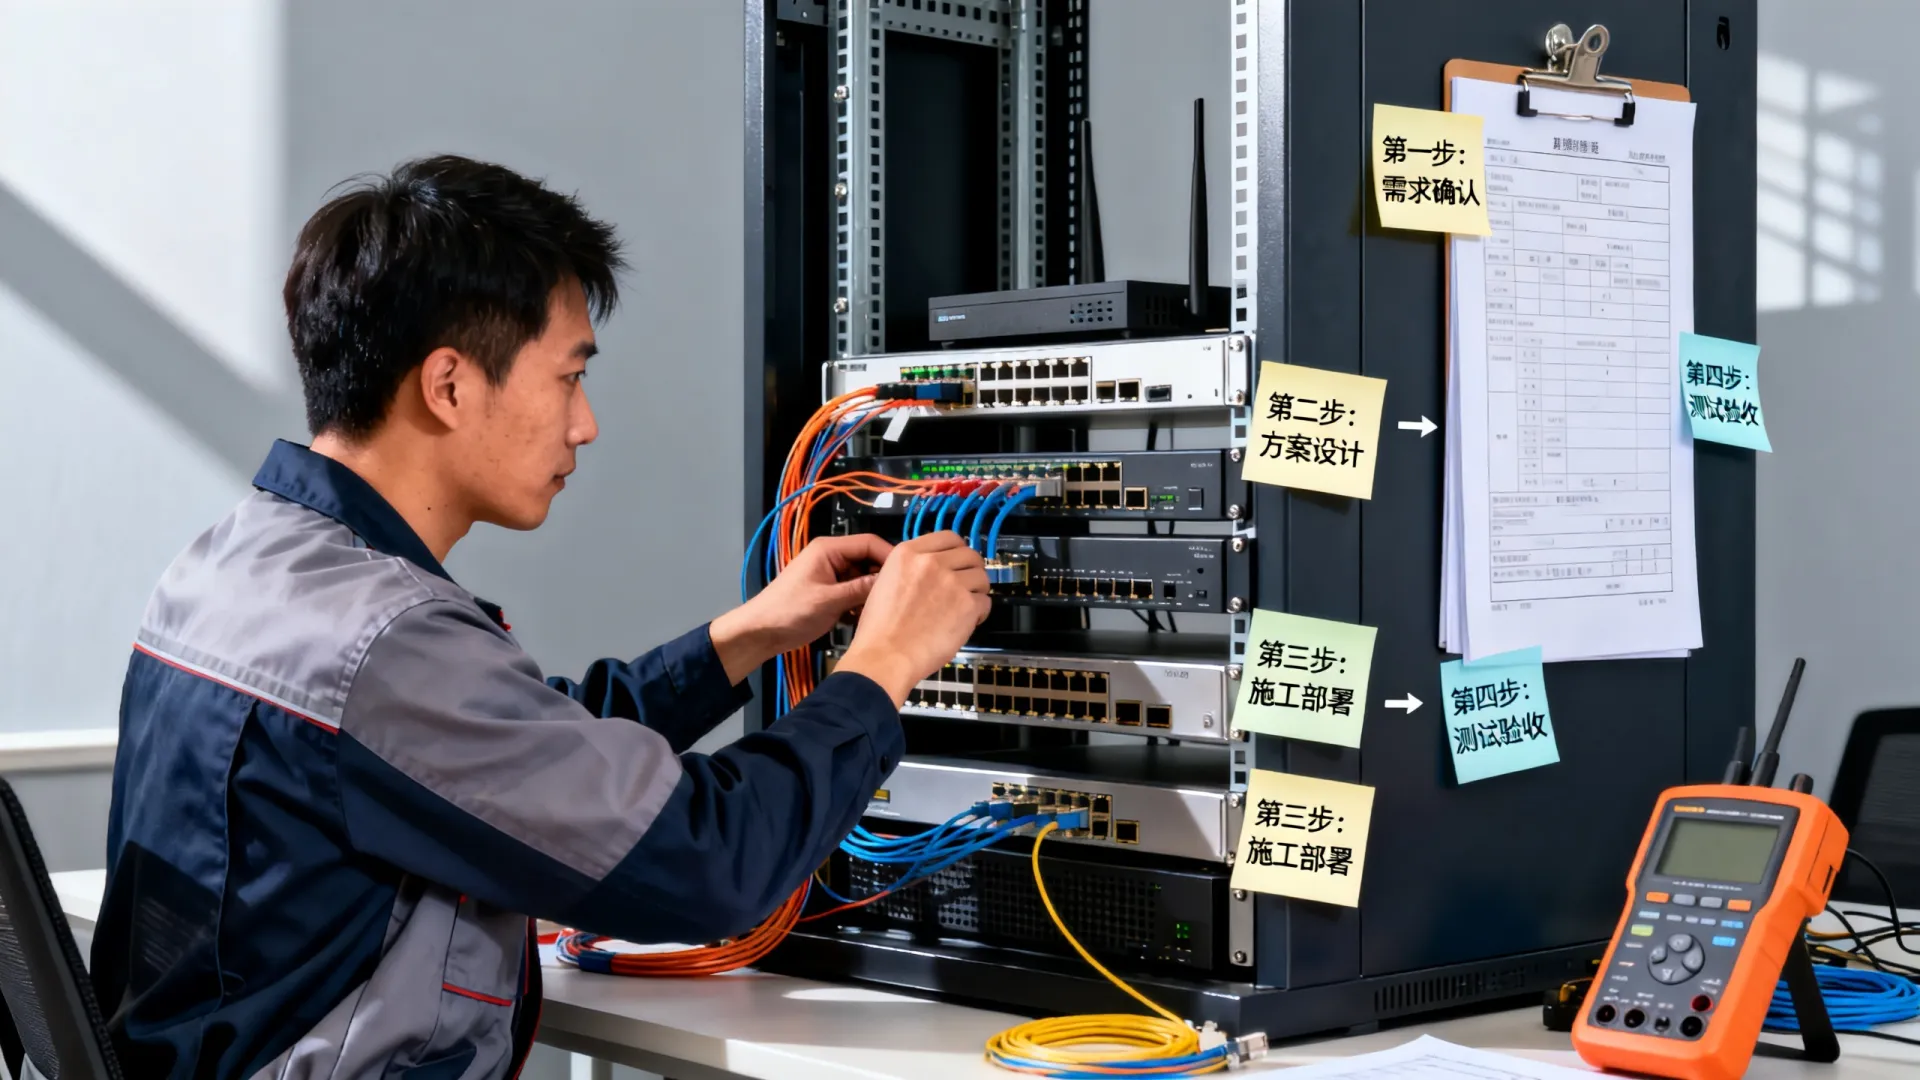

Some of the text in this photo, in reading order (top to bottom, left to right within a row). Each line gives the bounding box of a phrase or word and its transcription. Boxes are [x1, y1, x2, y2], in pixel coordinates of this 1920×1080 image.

[1382, 135, 1465, 167] 第一步：
[1382, 175, 1480, 206] 需求确认
[1686, 359, 1750, 390] 第四步：
[1266, 391, 1356, 426] 第二步：
[1260, 430, 1364, 468] 方案设计
[1257, 639, 1346, 674] 第三步：
[1248, 677, 1354, 716] 施工部署
[1451, 678, 1529, 716] 第四步：
[1453, 711, 1548, 754] 测试验收
[1255, 798, 1344, 833] 第三步：
[1246, 836, 1353, 876] 施工部署
